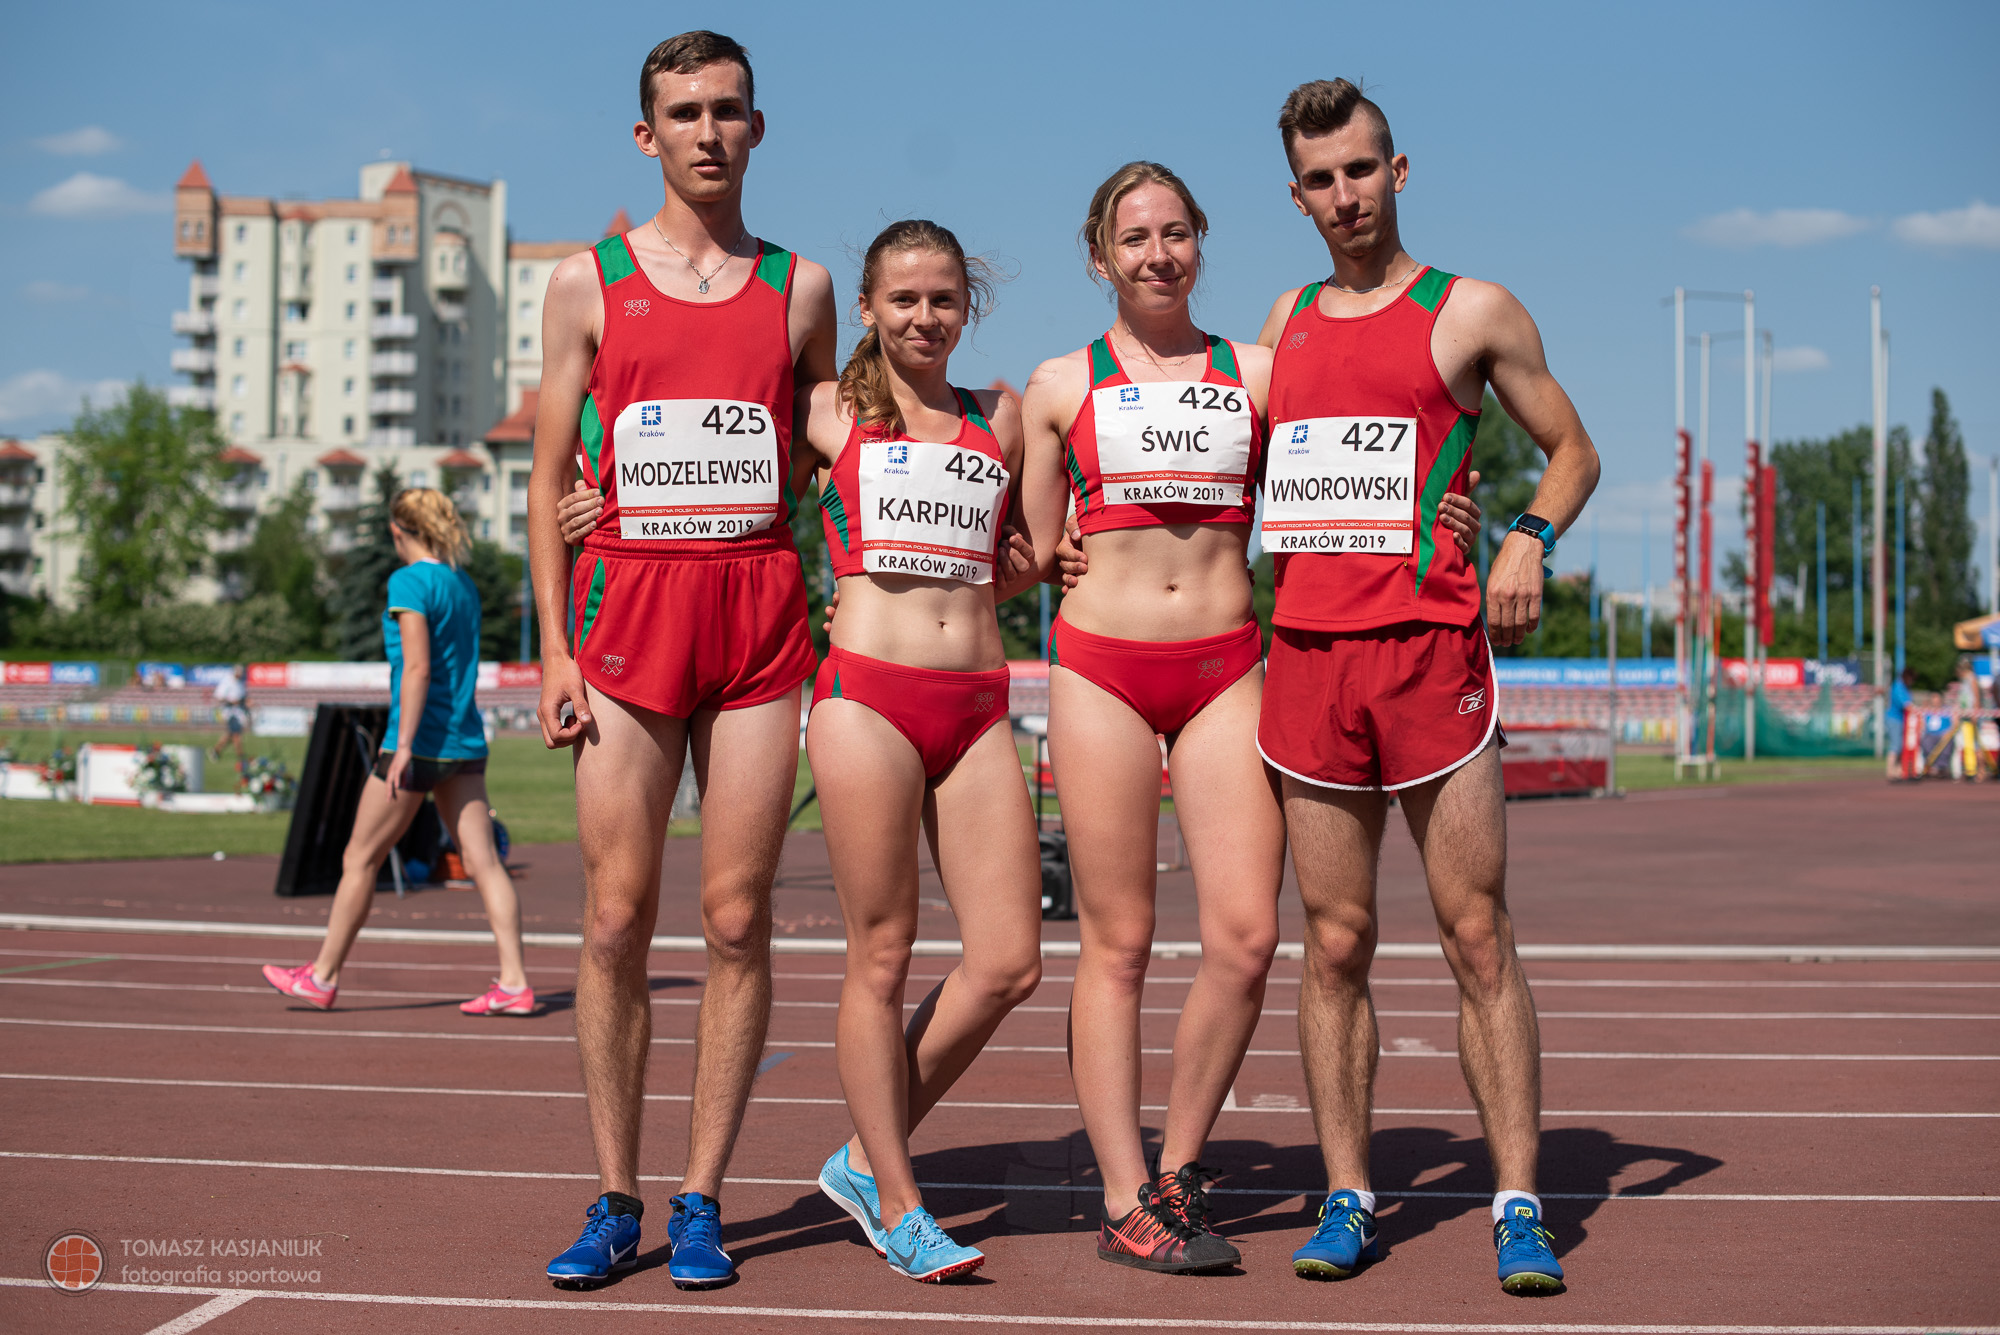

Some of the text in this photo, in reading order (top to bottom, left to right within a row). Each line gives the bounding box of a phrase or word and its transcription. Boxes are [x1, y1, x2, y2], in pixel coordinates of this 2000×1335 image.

[1178, 386, 1242, 412] 426
[702, 405, 766, 435] 425
[639, 430, 666, 438] Kraków
[1142, 426, 1210, 452] ŚWIĆ
[1342, 422, 1408, 452] 427
[622, 460, 772, 487] MODZELEWSKI
[884, 468, 910, 476] Kraków
[944, 452, 1004, 487] 424
[1124, 482, 1224, 501] KRAKÓW 2019
[1271, 476, 1408, 502] WNOROWSKI
[642, 517, 754, 536] KRAKÓW 2019
[878, 497, 990, 532] KARPIUK
[1281, 532, 1386, 549] KRAKÓW 2019
[878, 555, 978, 579] KRAKÓW 2019
